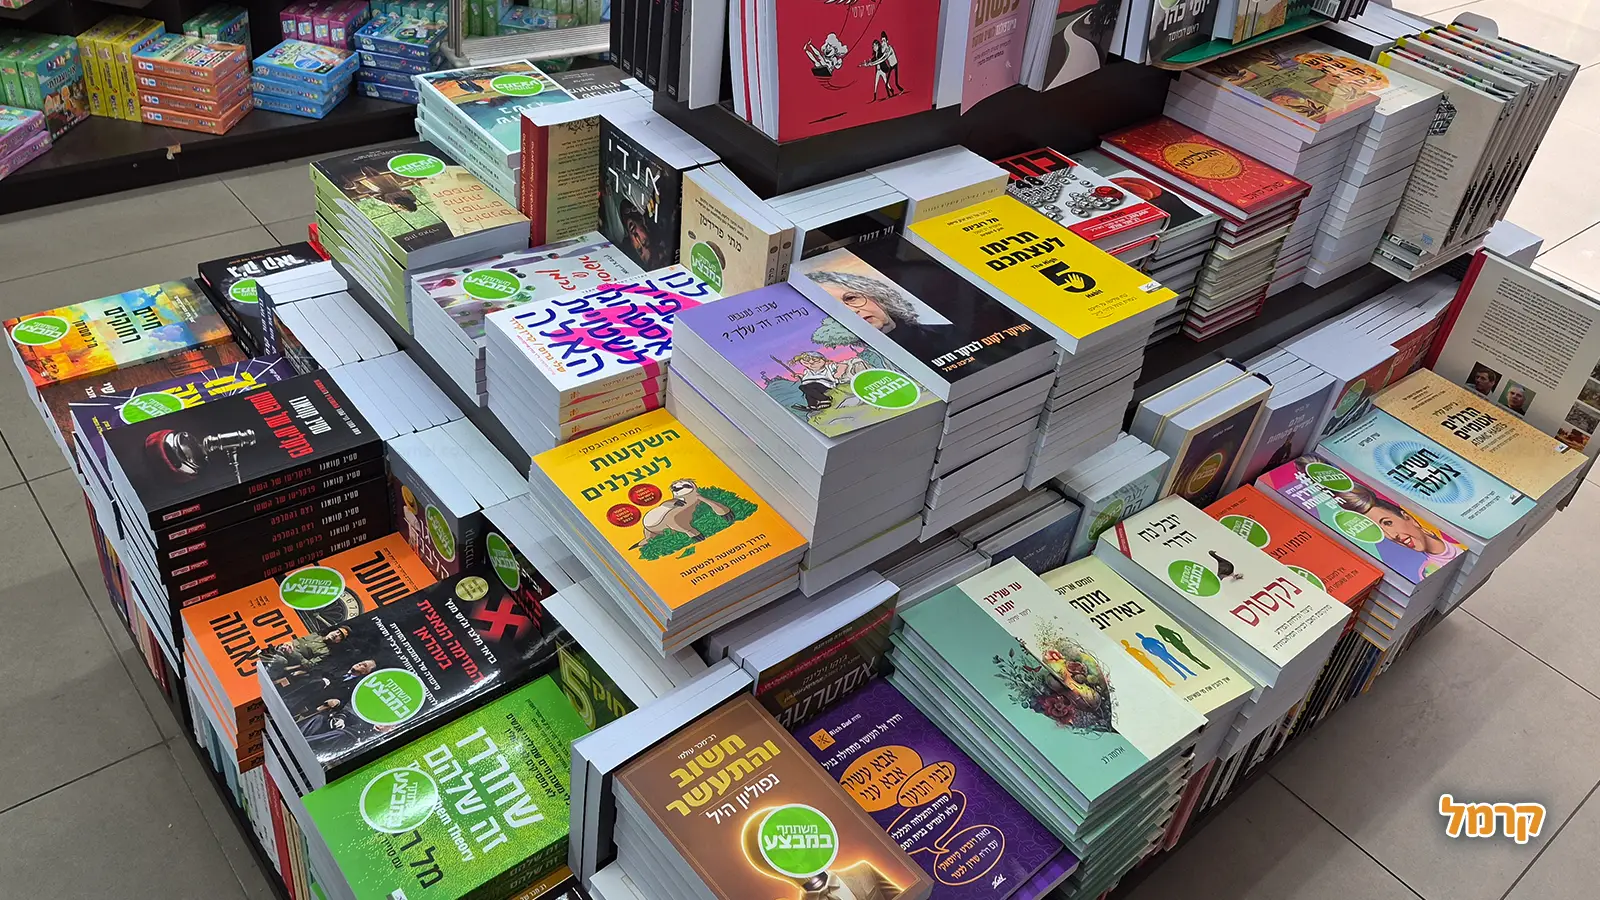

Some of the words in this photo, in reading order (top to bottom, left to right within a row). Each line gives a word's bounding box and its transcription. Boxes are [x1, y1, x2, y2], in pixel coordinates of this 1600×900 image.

[1163, 6, 1186, 31] כהן
[608, 138, 661, 196] אנדי
[1175, 149, 1225, 170] האלכימאי
[433, 184, 485, 199] הספרים
[452, 201, 504, 215] הסודיים
[463, 209, 513, 224] היומנים
[700, 213, 724, 239] פרידמן
[962, 220, 988, 233] רובינס
[987, 217, 1000, 225] מל
[727, 235, 742, 252] מתי
[979, 231, 1040, 256] תרימו
[985, 236, 1066, 272] לעצמכם
[1031, 262, 1042, 271] The
[1042, 257, 1059, 268] High
[692, 255, 721, 287] במבצע
[1038, 260, 1097, 294] 5
[1085, 289, 1104, 300] Habit
[132, 306, 164, 331] חיים
[755, 301, 778, 317] טוביה
[104, 306, 142, 344] רחוקים
[551, 299, 650, 365] לשטויות
[757, 315, 774, 330] זה
[1002, 323, 1032, 338] העיקר
[514, 308, 605, 378] האלה
[721, 322, 757, 345] שלך?
[981, 332, 1005, 346] לקום
[953, 340, 984, 357] לבוקר
[931, 352, 958, 367] חדש
[862, 378, 911, 404] במבצע
[243, 390, 282, 415] השטן
[288, 395, 319, 420] קוואנו
[263, 410, 293, 429] של
[304, 416, 332, 436] סטיב
[1440, 406, 1482, 431] הרגלים
[1453, 412, 1498, 441] אטומיים
[619, 426, 643, 442] תמיר
[1470, 431, 1493, 447] ATOMIC
[343, 452, 358, 464] סטיב
[589, 426, 681, 472] השקעות
[346, 470, 361, 480] סטיב
[1385, 447, 1440, 484] חשיבה
[580, 455, 674, 503] לעצלנים
[1411, 462, 1463, 498] צלולה
[343, 489, 359, 502] סטיב
[344, 506, 360, 518] סטיב
[352, 518, 367, 529] סטיב
[1148, 513, 1181, 533] יובל
[746, 532, 767, 546] הדרך
[1137, 527, 1161, 543] נח
[1162, 529, 1198, 549] הררי
[1284, 530, 1312, 553] להזמין
[714, 542, 747, 561] הפשוטה
[729, 541, 772, 566] ארוכת-טווח
[679, 557, 715, 578] להשקעה
[708, 561, 730, 577] בשוק
[283, 581, 339, 597] במבצע
[690, 573, 709, 586] ההון
[1008, 581, 1023, 592] עד
[1076, 575, 1096, 589] תומס
[1186, 563, 1205, 595] במבצע
[983, 586, 1011, 606] שליבך
[1068, 588, 1112, 616] מוקף
[1228, 576, 1303, 628] נקסוס
[993, 599, 1016, 617] יתנגן
[416, 599, 455, 641] הנאצית
[389, 622, 406, 643] הסודית
[466, 627, 485, 647] מלצר
[403, 640, 422, 664] התוכנית
[412, 625, 453, 671] בטהראן
[480, 646, 498, 665] בראד
[447, 639, 487, 684] המזימה
[425, 669, 441, 691] סיפורה
[363, 676, 412, 719] במבצע
[385, 678, 413, 703] משתתף
[505, 712, 523, 733] אנשים
[828, 725, 843, 737] Rich
[842, 718, 853, 730] Dad
[875, 722, 889, 734] אל
[885, 713, 904, 728] הדרך
[522, 732, 543, 760] שמיליוני
[859, 729, 880, 745] העושר
[668, 733, 748, 789] חשוב
[677, 746, 696, 761] עולמי
[836, 741, 862, 761] מתחילה
[869, 749, 899, 773] אבא
[1109, 745, 1126, 760] אלומה
[526, 758, 550, 789] מפסיקים
[538, 758, 553, 776] חיים
[820, 756, 839, 771] בגיל
[928, 762, 953, 784] לבני
[422, 743, 487, 816] שלהם
[455, 727, 545, 829] שחררו
[549, 772, 566, 795] משנה
[665, 739, 783, 818] והתעשר
[840, 766, 873, 792] עשיר
[878, 766, 908, 790] אבא
[545, 787, 557, 799] לא
[735, 773, 782, 811] נפוליון
[859, 784, 882, 802] עני
[900, 780, 935, 805] הנוער
[705, 801, 738, 826] היל
[931, 795, 950, 812] סודות
[944, 803, 959, 818] שלא
[910, 805, 935, 828] ההצלחה
[925, 812, 947, 831] לומדים
[469, 815, 508, 854] זה
[775, 824, 819, 835] משתתף
[912, 828, 929, 842] בבית
[975, 827, 992, 842] מאת
[446, 825, 476, 863] Theory
[764, 833, 834, 851] במבצע
[959, 838, 978, 855] רוברט
[988, 839, 1000, 850] עם
[408, 846, 445, 890] מל
[936, 850, 963, 873] קיוסאקי
[965, 852, 982, 870] שרון
[950, 864, 969, 880] לכטר
